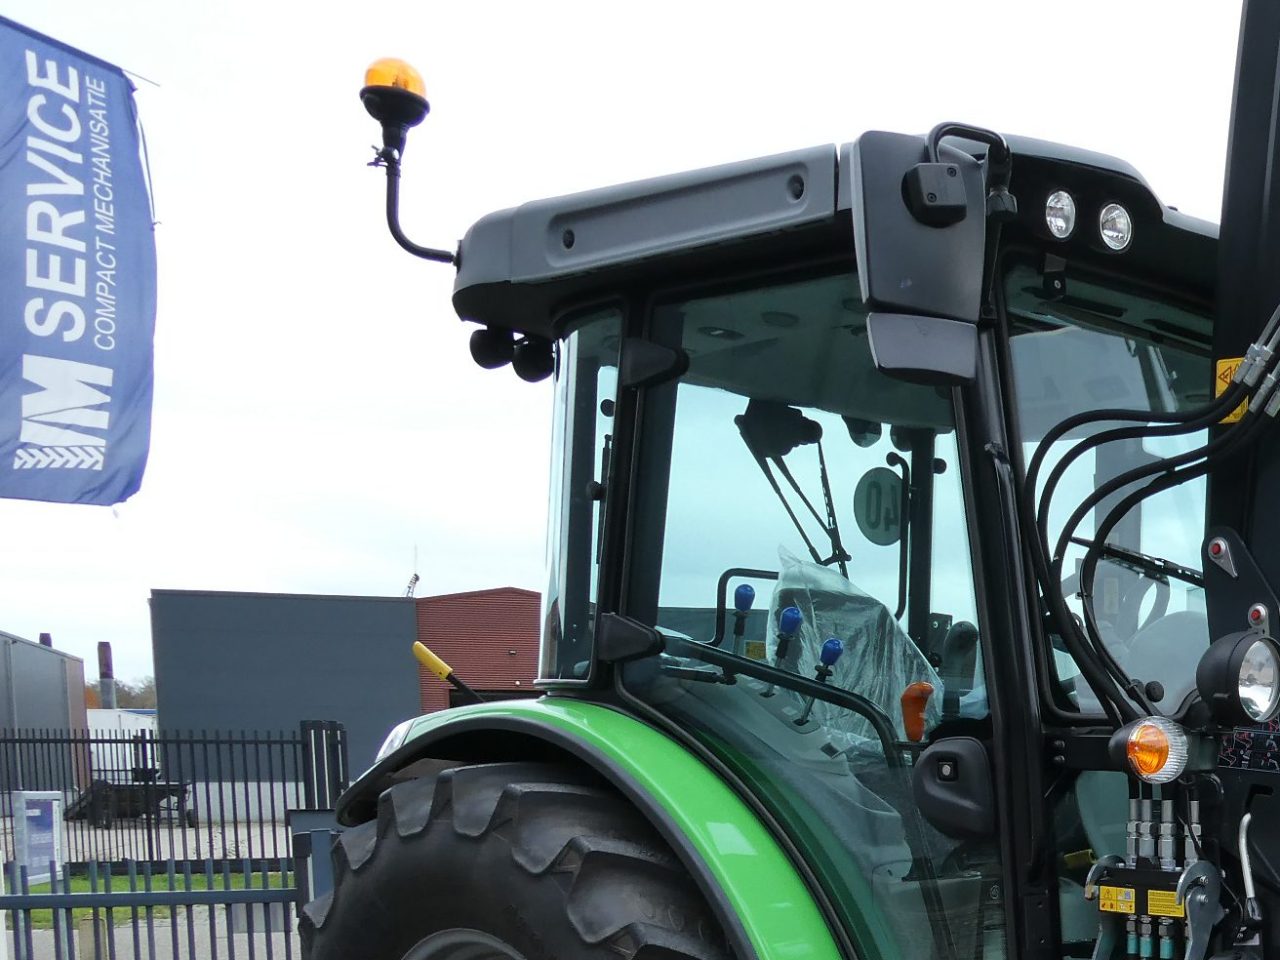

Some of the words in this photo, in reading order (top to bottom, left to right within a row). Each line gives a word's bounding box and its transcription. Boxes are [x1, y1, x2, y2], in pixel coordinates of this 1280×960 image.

[24, 49, 87, 342] SERVICE
[85, 74, 116, 235] MECHANISATIE
[94, 236, 117, 351] COMPACT
